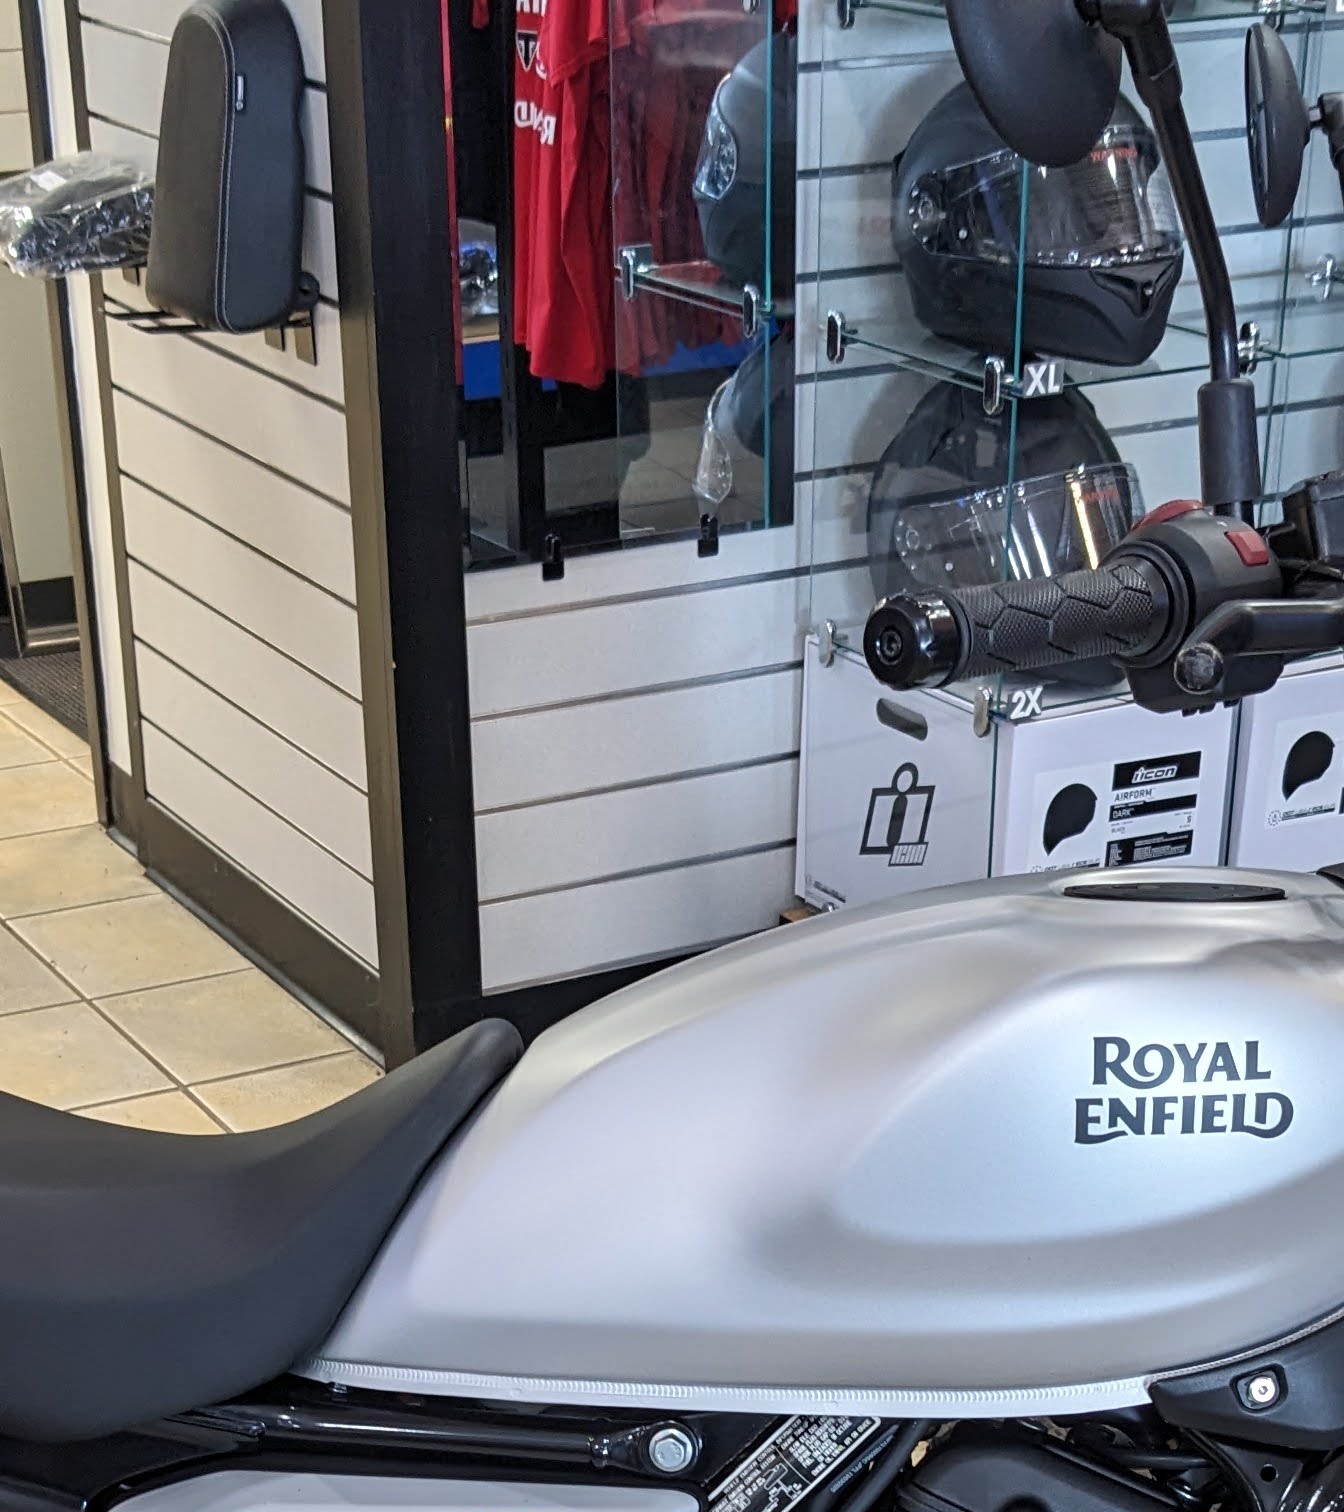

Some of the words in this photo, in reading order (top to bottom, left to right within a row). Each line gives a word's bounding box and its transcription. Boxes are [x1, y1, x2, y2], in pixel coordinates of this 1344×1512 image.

[1026, 363, 1061, 397] XL
[1010, 686, 1044, 720] 2X
[1114, 788, 1154, 802] AIRFORM
[1092, 1036, 1272, 1089] ROYAL
[1074, 1092, 1294, 1145] ENFIELD
